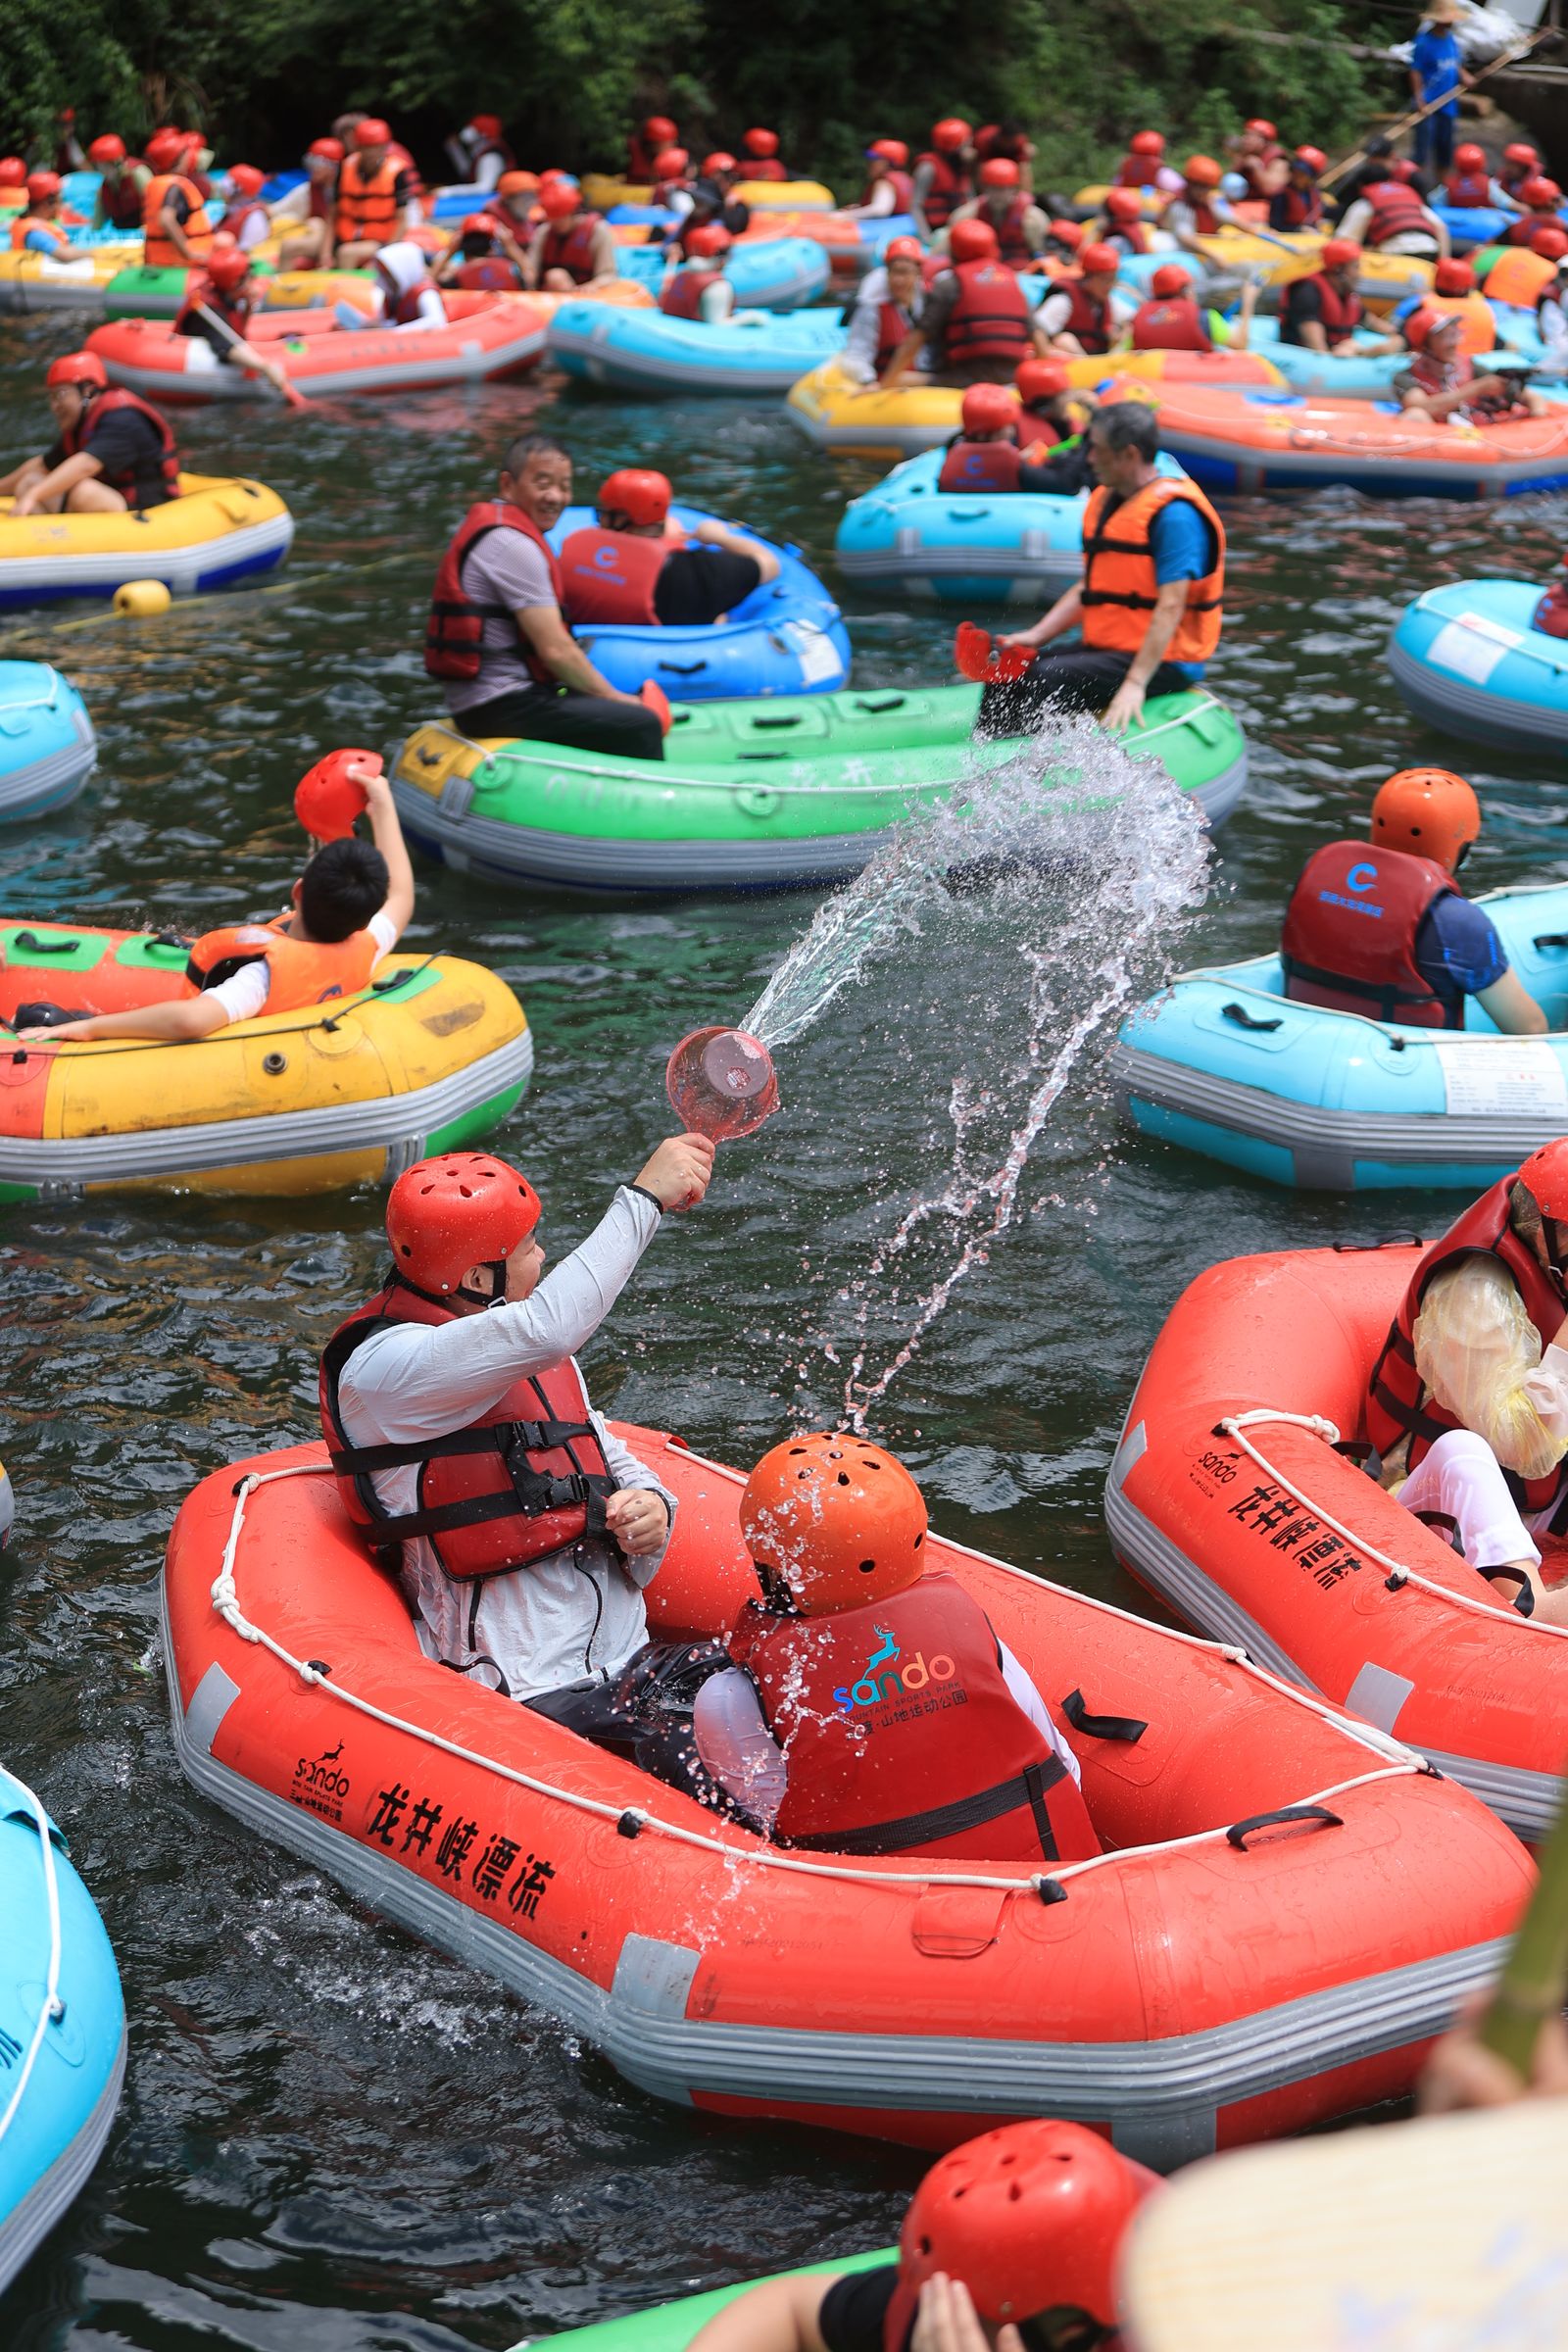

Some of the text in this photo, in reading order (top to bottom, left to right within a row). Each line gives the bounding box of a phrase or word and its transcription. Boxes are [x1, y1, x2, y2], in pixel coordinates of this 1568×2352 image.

[1198, 1451, 1237, 1483] sando
[1227, 1485, 1362, 1591] 龙井峡漂流
[833, 1651, 956, 1713] sando
[847, 1681, 961, 1723] OUNTAIN SPORTS PARK
[295, 1758, 350, 1797] sando
[368, 1783, 556, 1921] 龙井峡漂流
